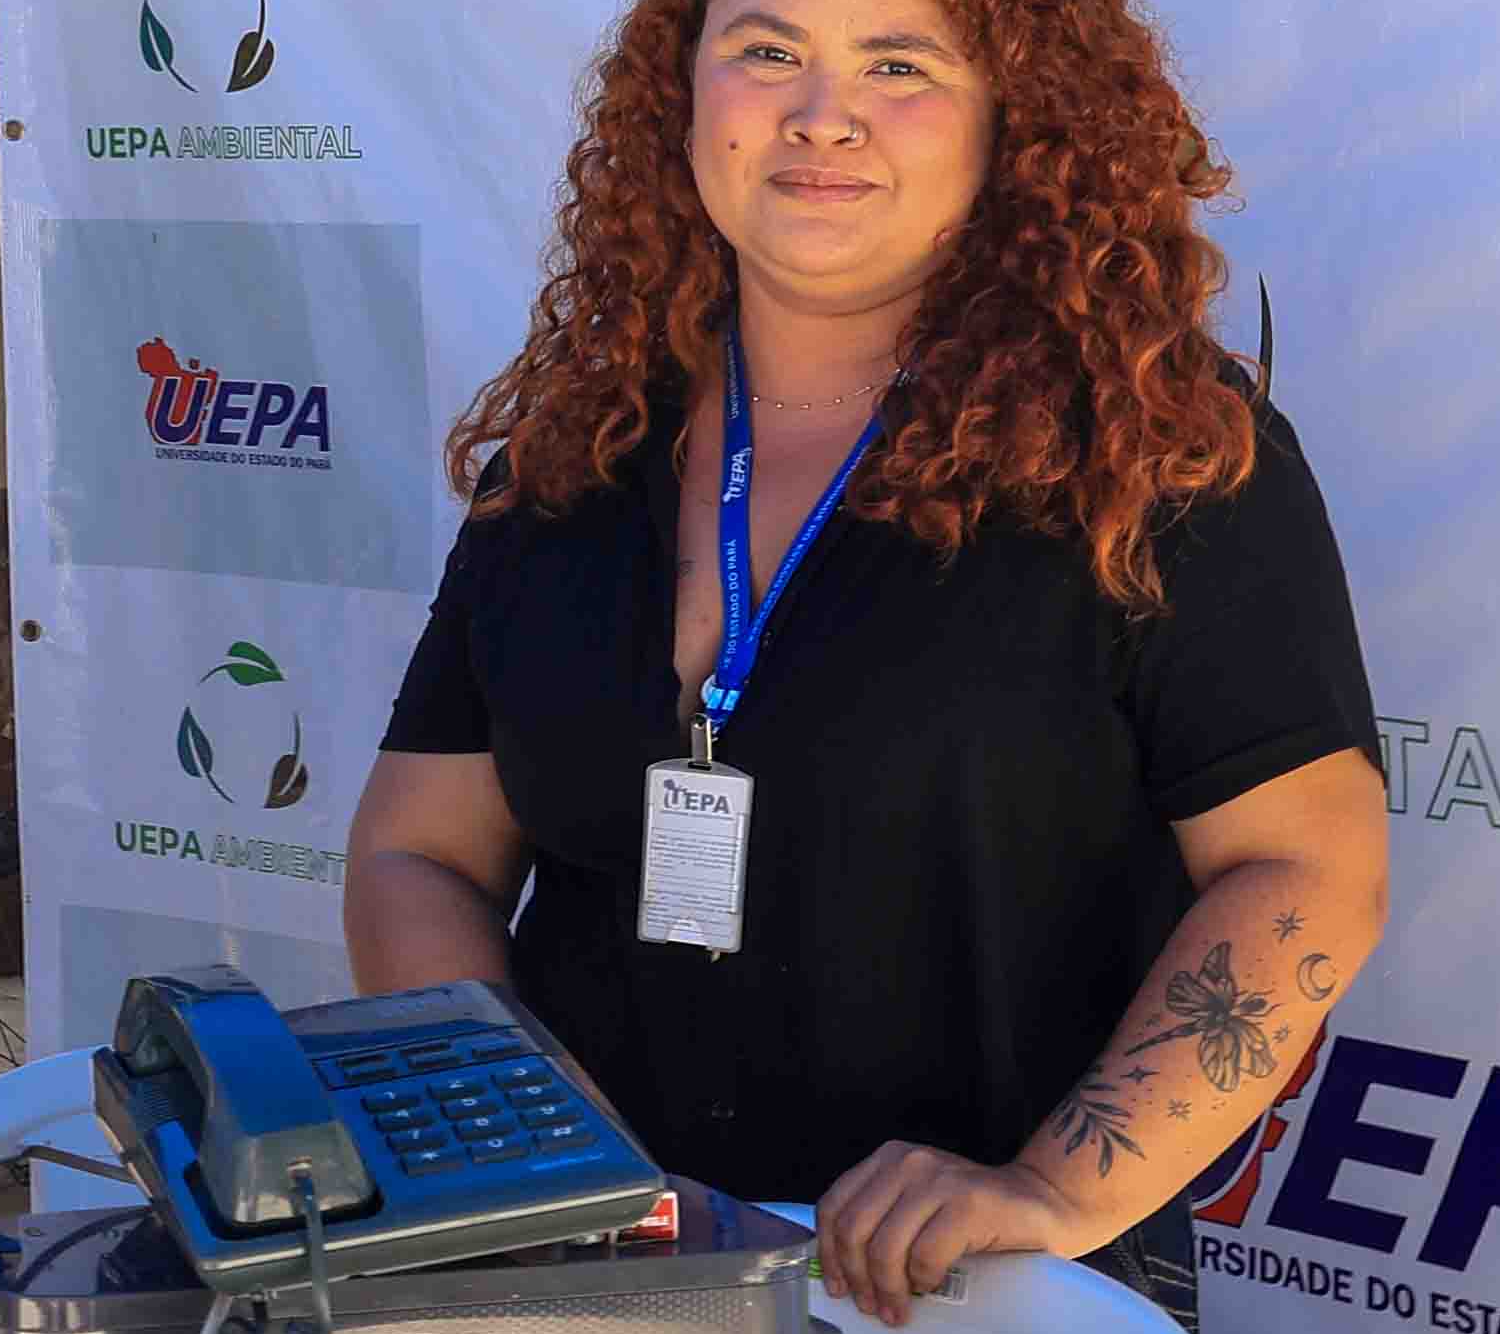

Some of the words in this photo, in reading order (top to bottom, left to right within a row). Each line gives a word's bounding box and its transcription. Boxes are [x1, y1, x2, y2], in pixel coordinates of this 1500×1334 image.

[87, 126, 173, 161] UEPA
[177, 122, 363, 163] AMBIENTAL
[153, 377, 333, 453] UEPA
[115, 820, 204, 863] UEPA
[1366, 1274, 1417, 1319] DO
